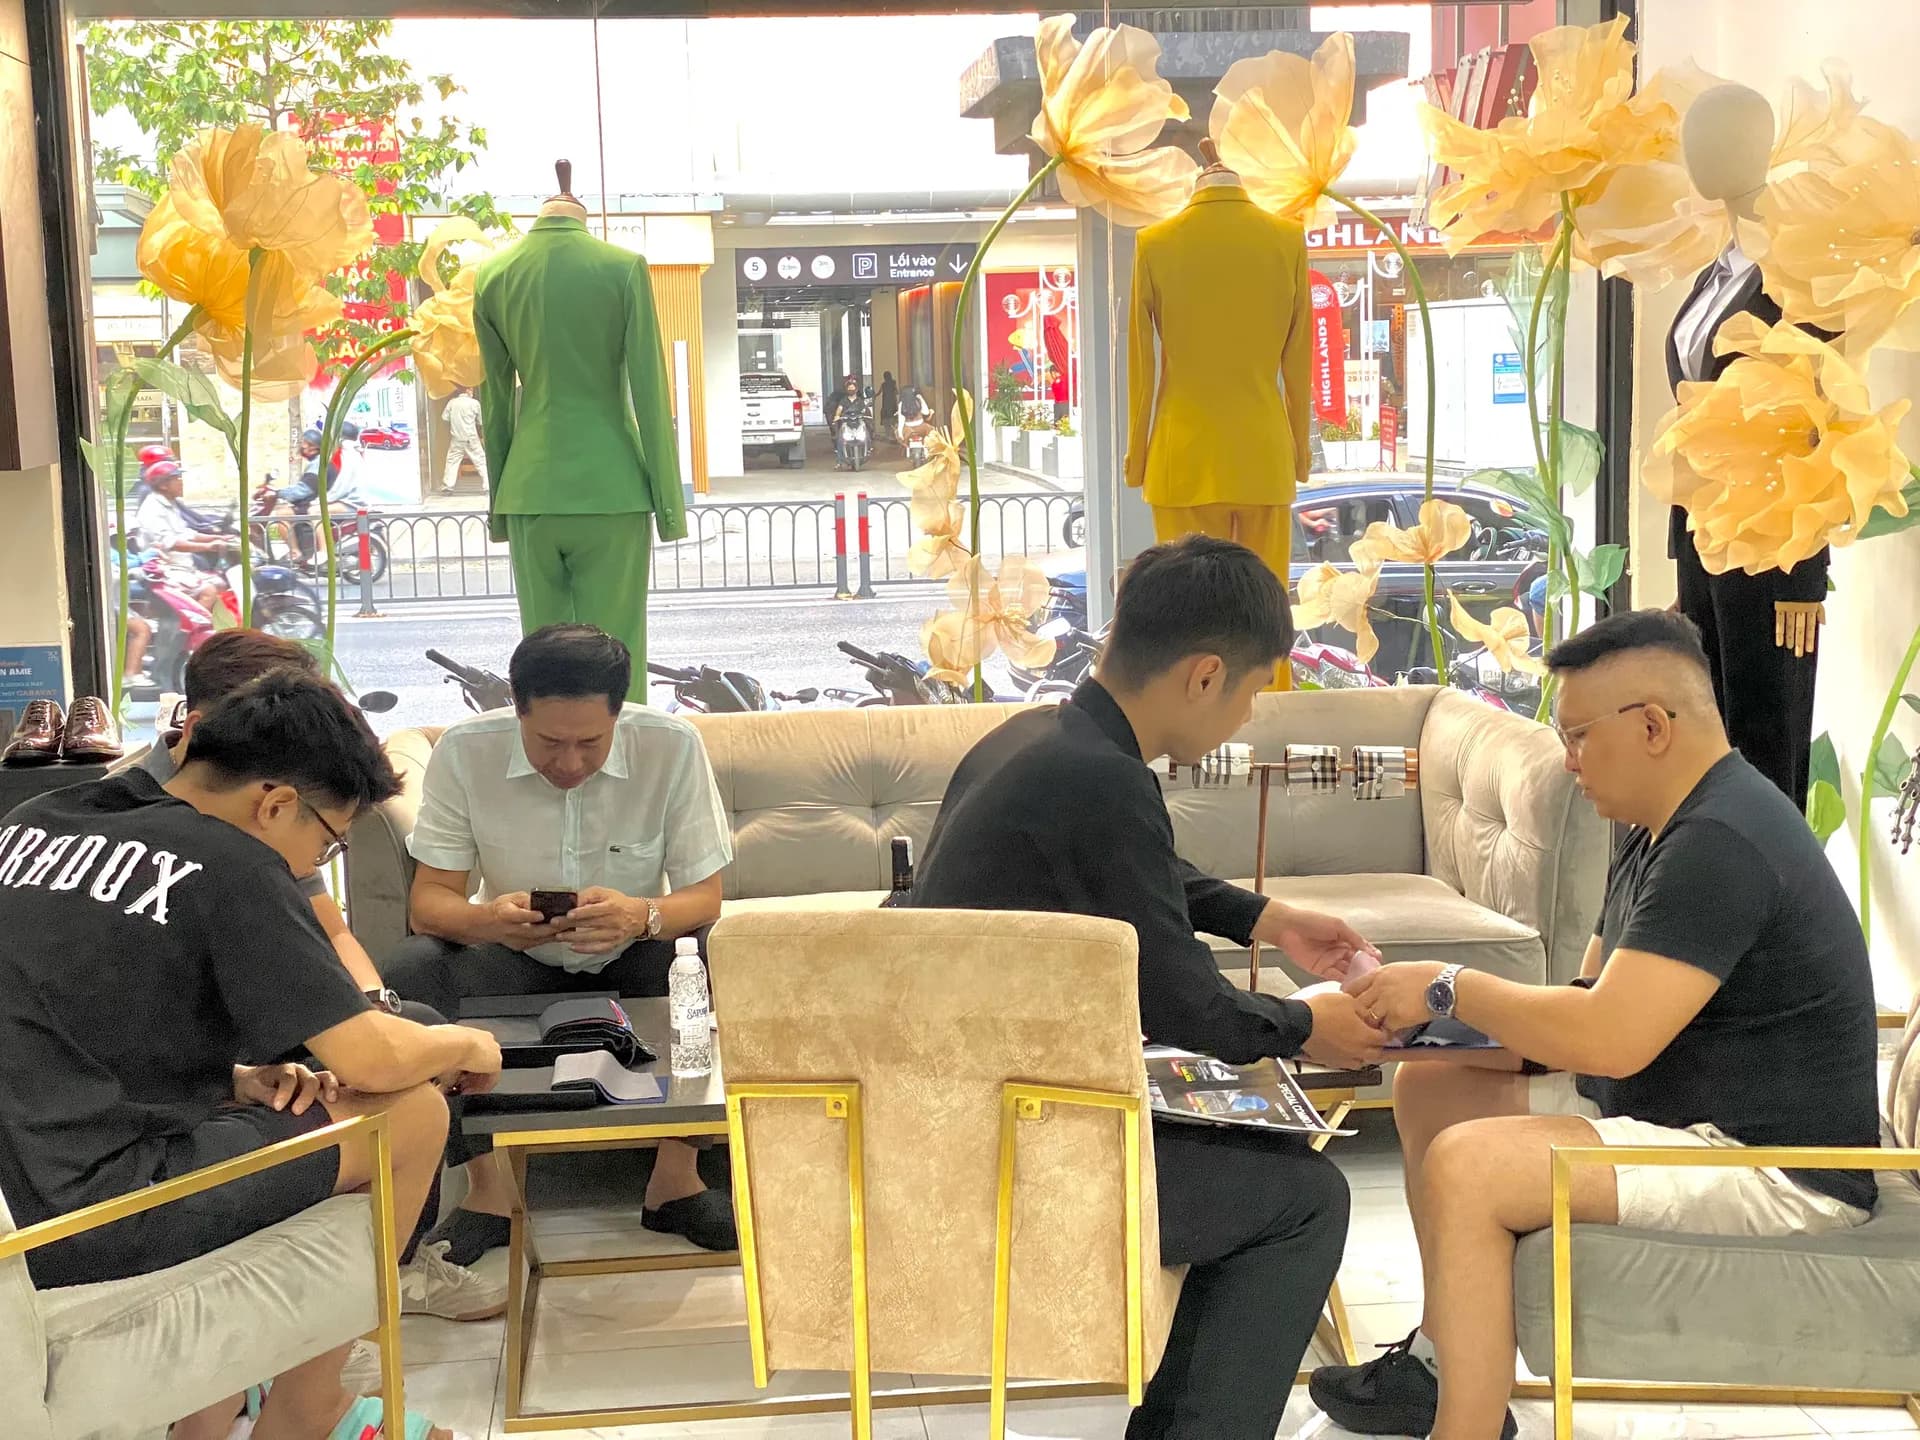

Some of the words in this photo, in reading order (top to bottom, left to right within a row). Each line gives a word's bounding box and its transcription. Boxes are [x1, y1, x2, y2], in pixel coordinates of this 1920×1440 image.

[752, 262, 759, 272] 5
[890, 253, 908, 268] Lối
[912, 254, 936, 267] vào
[890, 268, 935, 278] Entrance
[1317, 316, 1333, 407] HIGHLANDS
